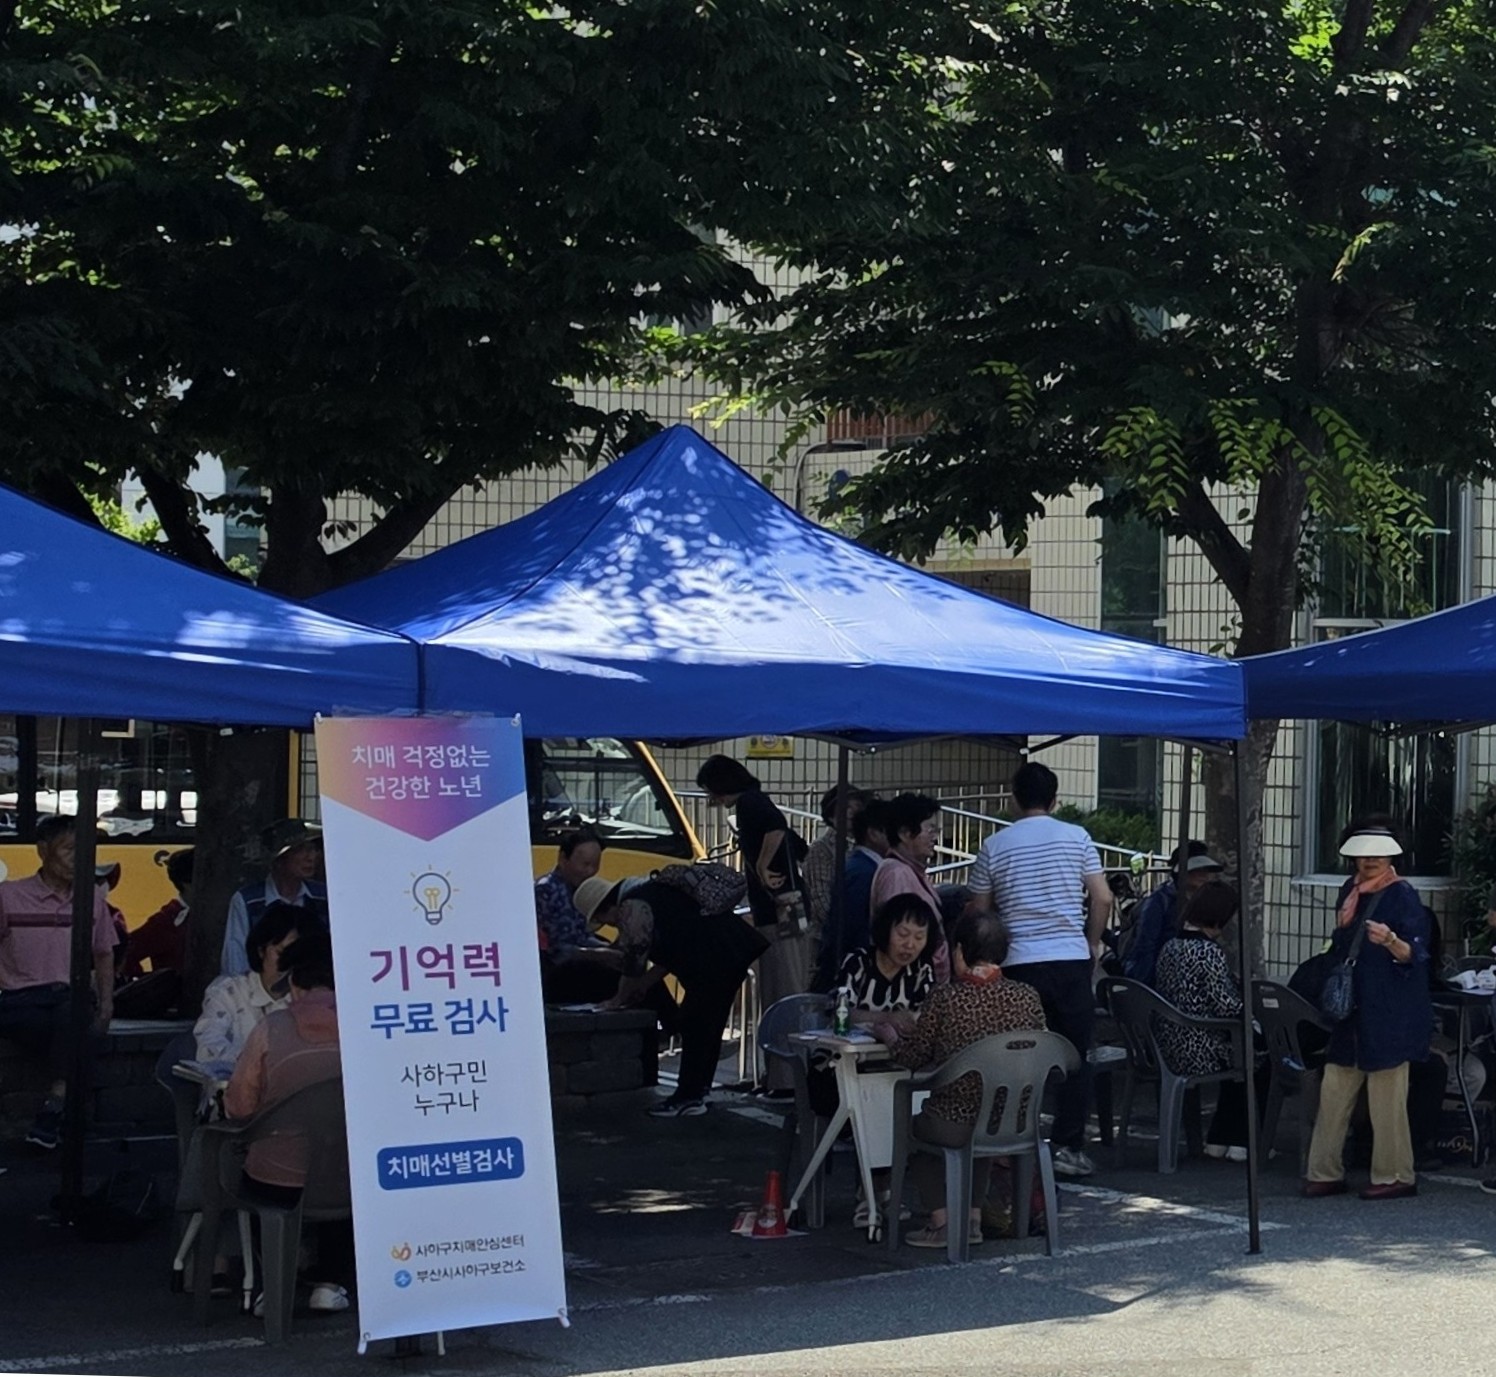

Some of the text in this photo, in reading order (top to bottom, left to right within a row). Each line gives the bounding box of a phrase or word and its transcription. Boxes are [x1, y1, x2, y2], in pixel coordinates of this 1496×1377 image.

[351, 744, 490, 769] 치매 걱정없는
[365, 774, 482, 800] 건강한 노년
[369, 942, 502, 991] 기억력
[370, 996, 509, 1039] 무료 검사
[401, 1060, 488, 1087] 사하구민
[414, 1090, 480, 1116] 누구나
[387, 1146, 514, 1179] 치매선별검사
[416, 1234, 525, 1258] 사하구치매안심센터
[416, 1259, 526, 1283] 부산시사하구보건소
